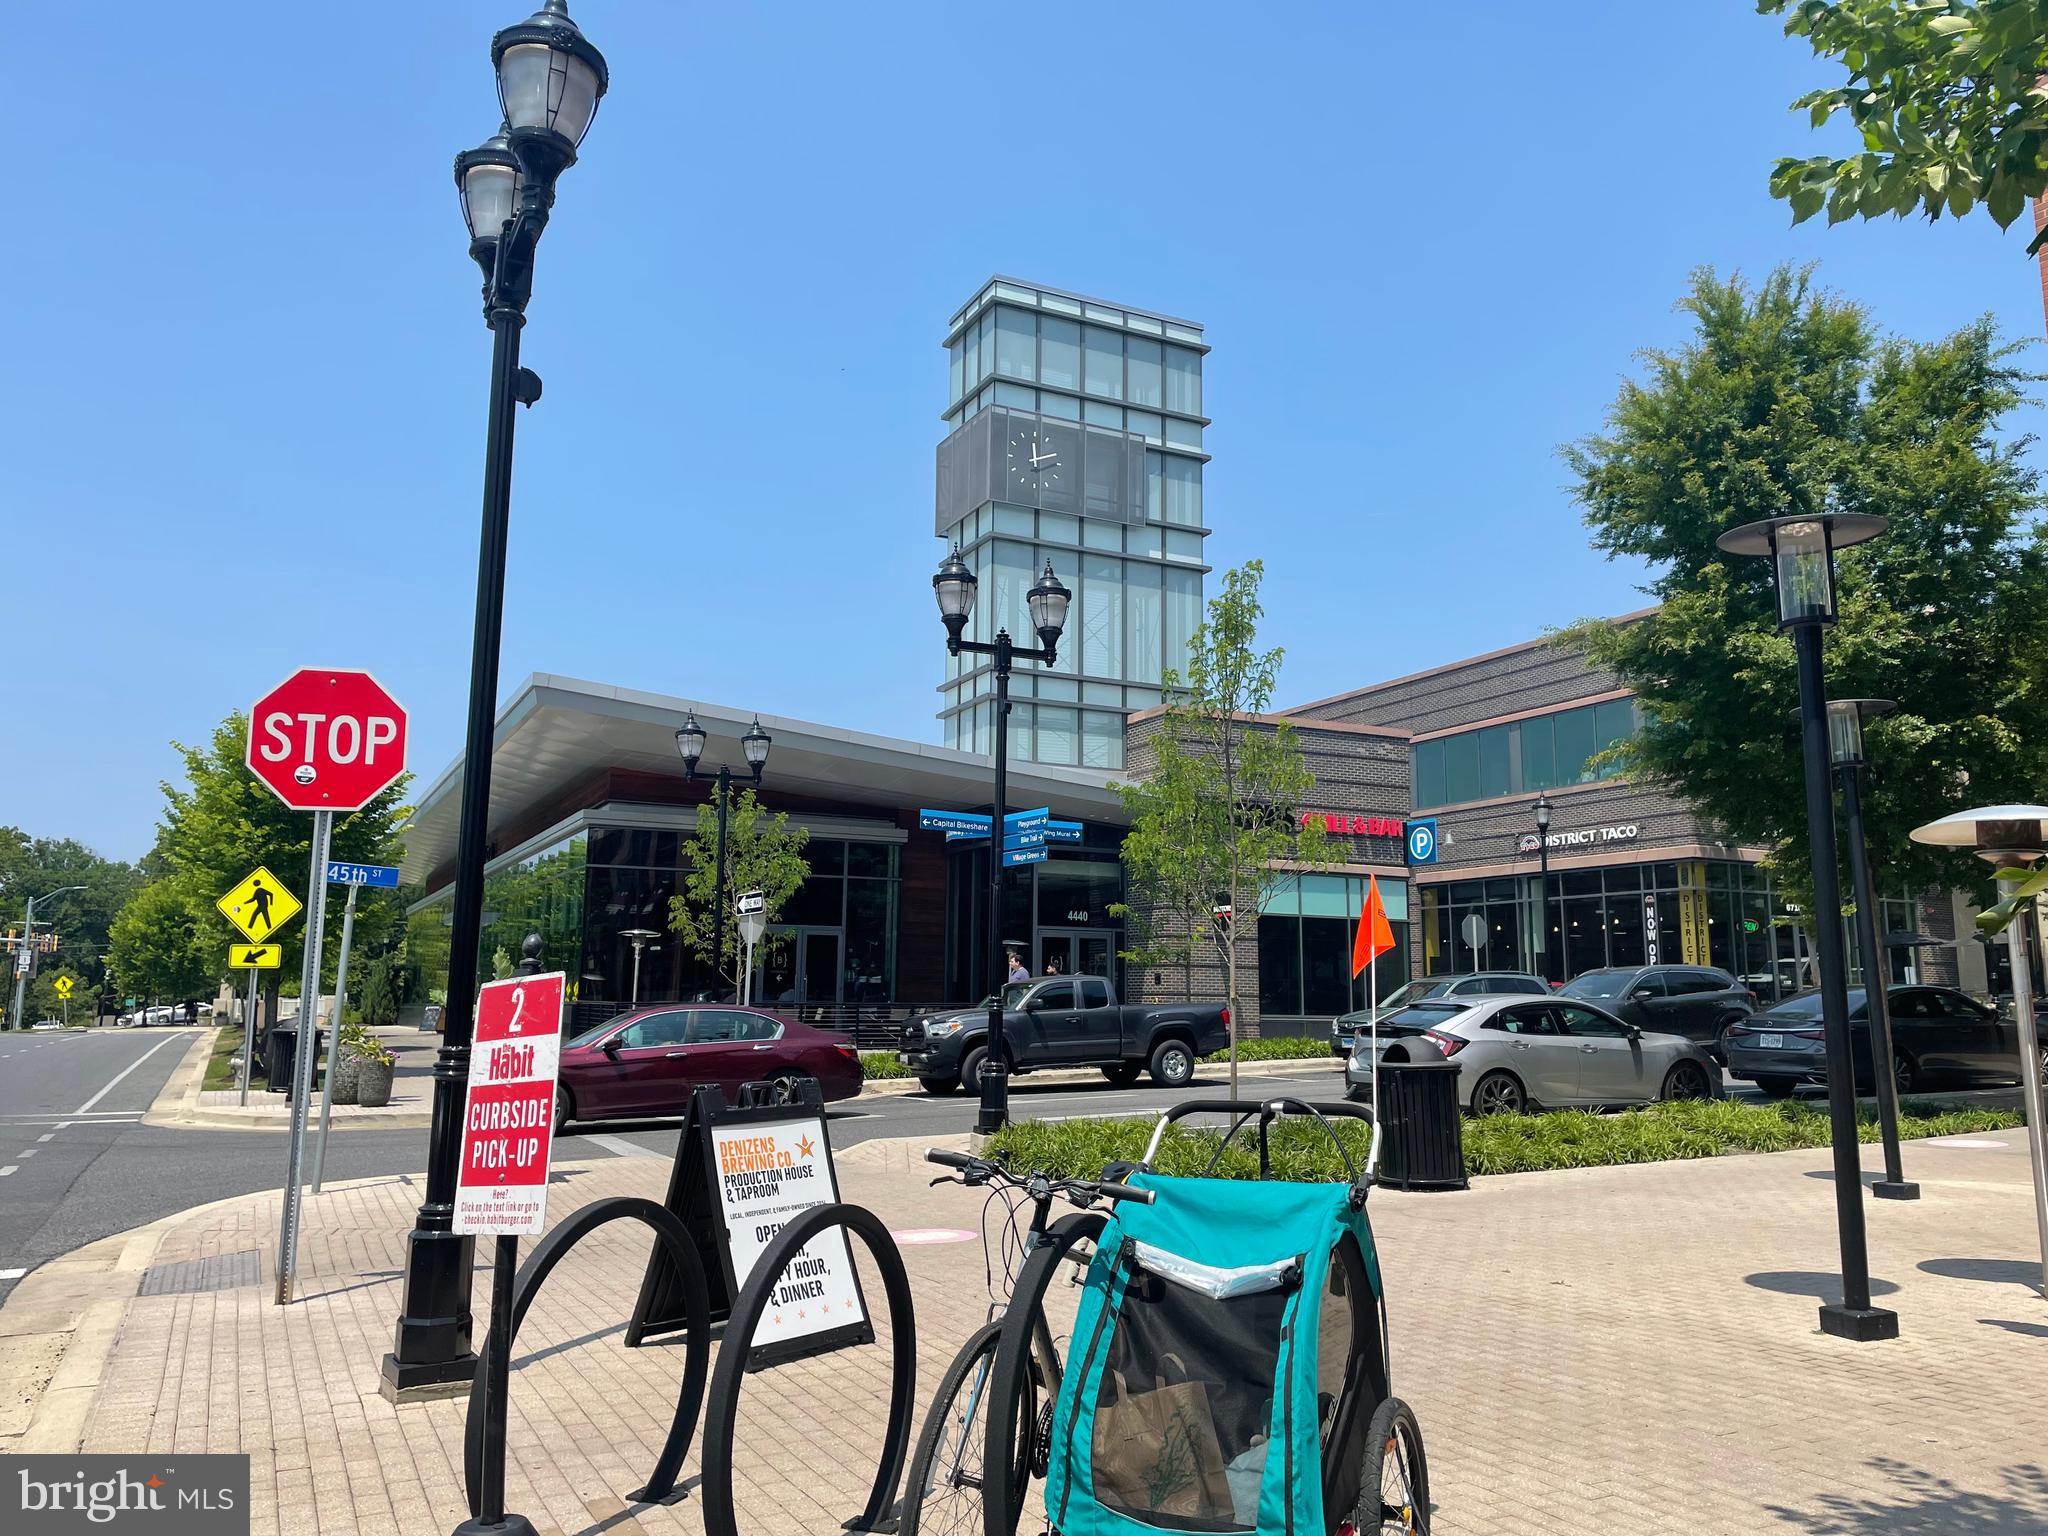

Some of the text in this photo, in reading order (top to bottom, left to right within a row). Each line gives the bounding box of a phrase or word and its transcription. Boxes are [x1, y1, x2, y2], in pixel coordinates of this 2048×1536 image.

[260, 712, 398, 765] STOP
[932, 818, 988, 832] Capital Bikeshare
[1018, 819, 1041, 828] Playground
[1353, 815, 1365, 834] &
[1368, 817, 1403, 836] BAR
[1600, 825, 1638, 841] TACO
[1416, 833, 1428, 854] P
[328, 866, 383, 883] 45th ST
[1067, 910, 1088, 921] 4440
[1785, 903, 1801, 912] 671
[1646, 906, 1656, 966] NOW OP
[1683, 894, 1693, 962] DISTRICT
[1697, 894, 1707, 962] DISTRICT
[508, 987, 525, 1033] 2
[502, 1043, 511, 1053] the
[488, 1044, 535, 1081] Habit
[470, 1098, 549, 1132] CURBSIDE
[472, 1137, 539, 1169] PICK-UP
[719, 1136, 776, 1158] DENIZENS
[721, 1150, 796, 1175] BREWING CO.
[724, 1164, 814, 1188] PRODUCTION HOUSE
[492, 1188, 509, 1199] Here?
[726, 1182, 780, 1204] & TAPROOM
[461, 1200, 540, 1213] Click on the text link or go to
[729, 1212, 744, 1220] LOCAL,
[744, 1207, 773, 1218] INDEPENDENT,
[776, 1202, 804, 1213] FAMILY-OWNED
[464, 1213, 533, 1226] checkin.habitburger.com
[794, 1258, 831, 1280] HOUR,
[770, 1279, 825, 1307] & DINNER
